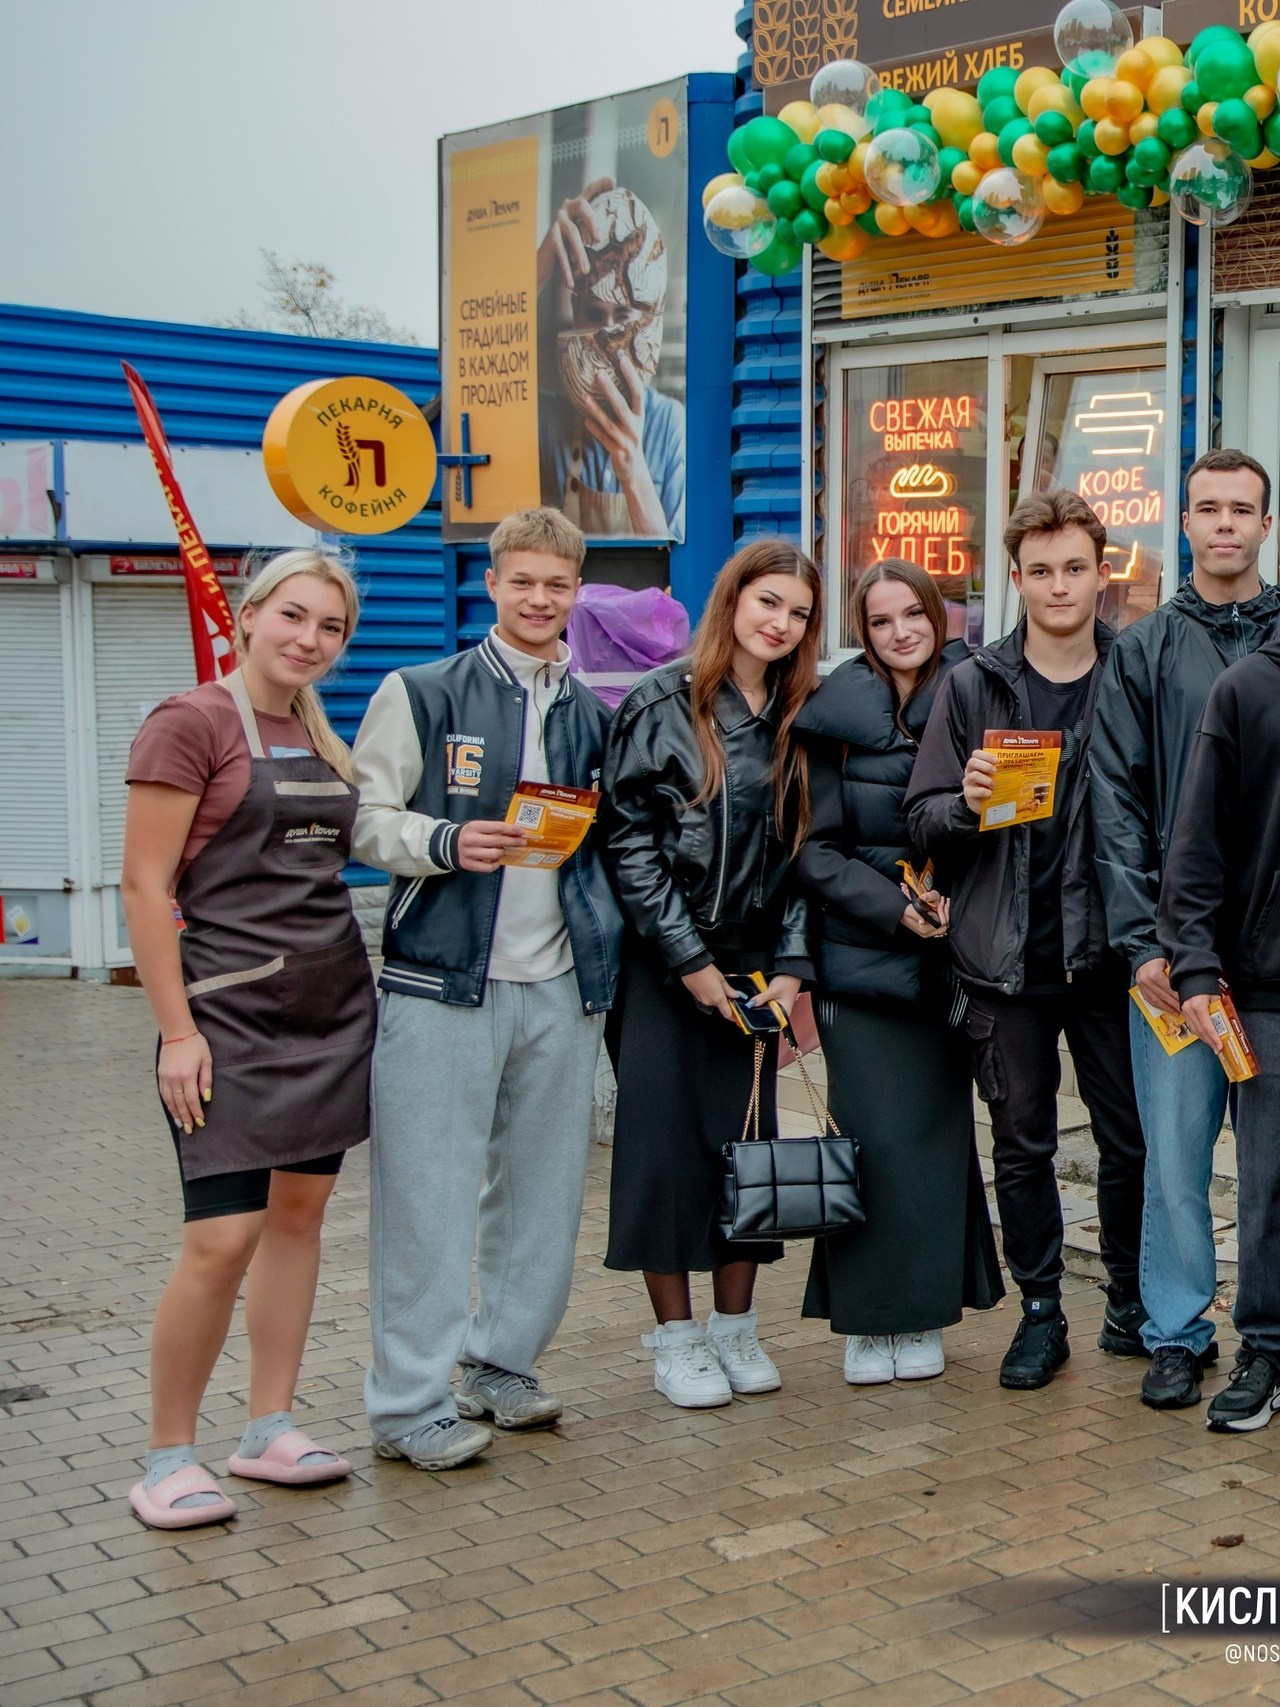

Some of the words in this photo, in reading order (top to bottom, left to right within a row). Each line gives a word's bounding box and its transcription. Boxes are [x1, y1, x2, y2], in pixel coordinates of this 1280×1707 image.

[964, 42, 1024, 81] ХЛЕБ
[460, 290, 528, 320] СЕМЕЙНЫЕ
[459, 321, 529, 350] ТРАДИЦИИ
[459, 357, 467, 378] В
[469, 351, 530, 377] КАЖДОМ
[461, 380, 528, 408] ПРОДУКТЕ
[316, 397, 404, 430] ПЕКАРНЯ
[870, 396, 970, 433] СВЕЖАЯ
[885, 431, 954, 452] ВЫПЕЧКА
[1079, 466, 1145, 497] КОФЕ
[318, 484, 407, 517] КОФЕЙНЯ
[1090, 490, 1161, 526] ОБОЙ
[878, 507, 960, 536] ГОРЯЧИЙ
[872, 537, 966, 576] ХЛЕБ
